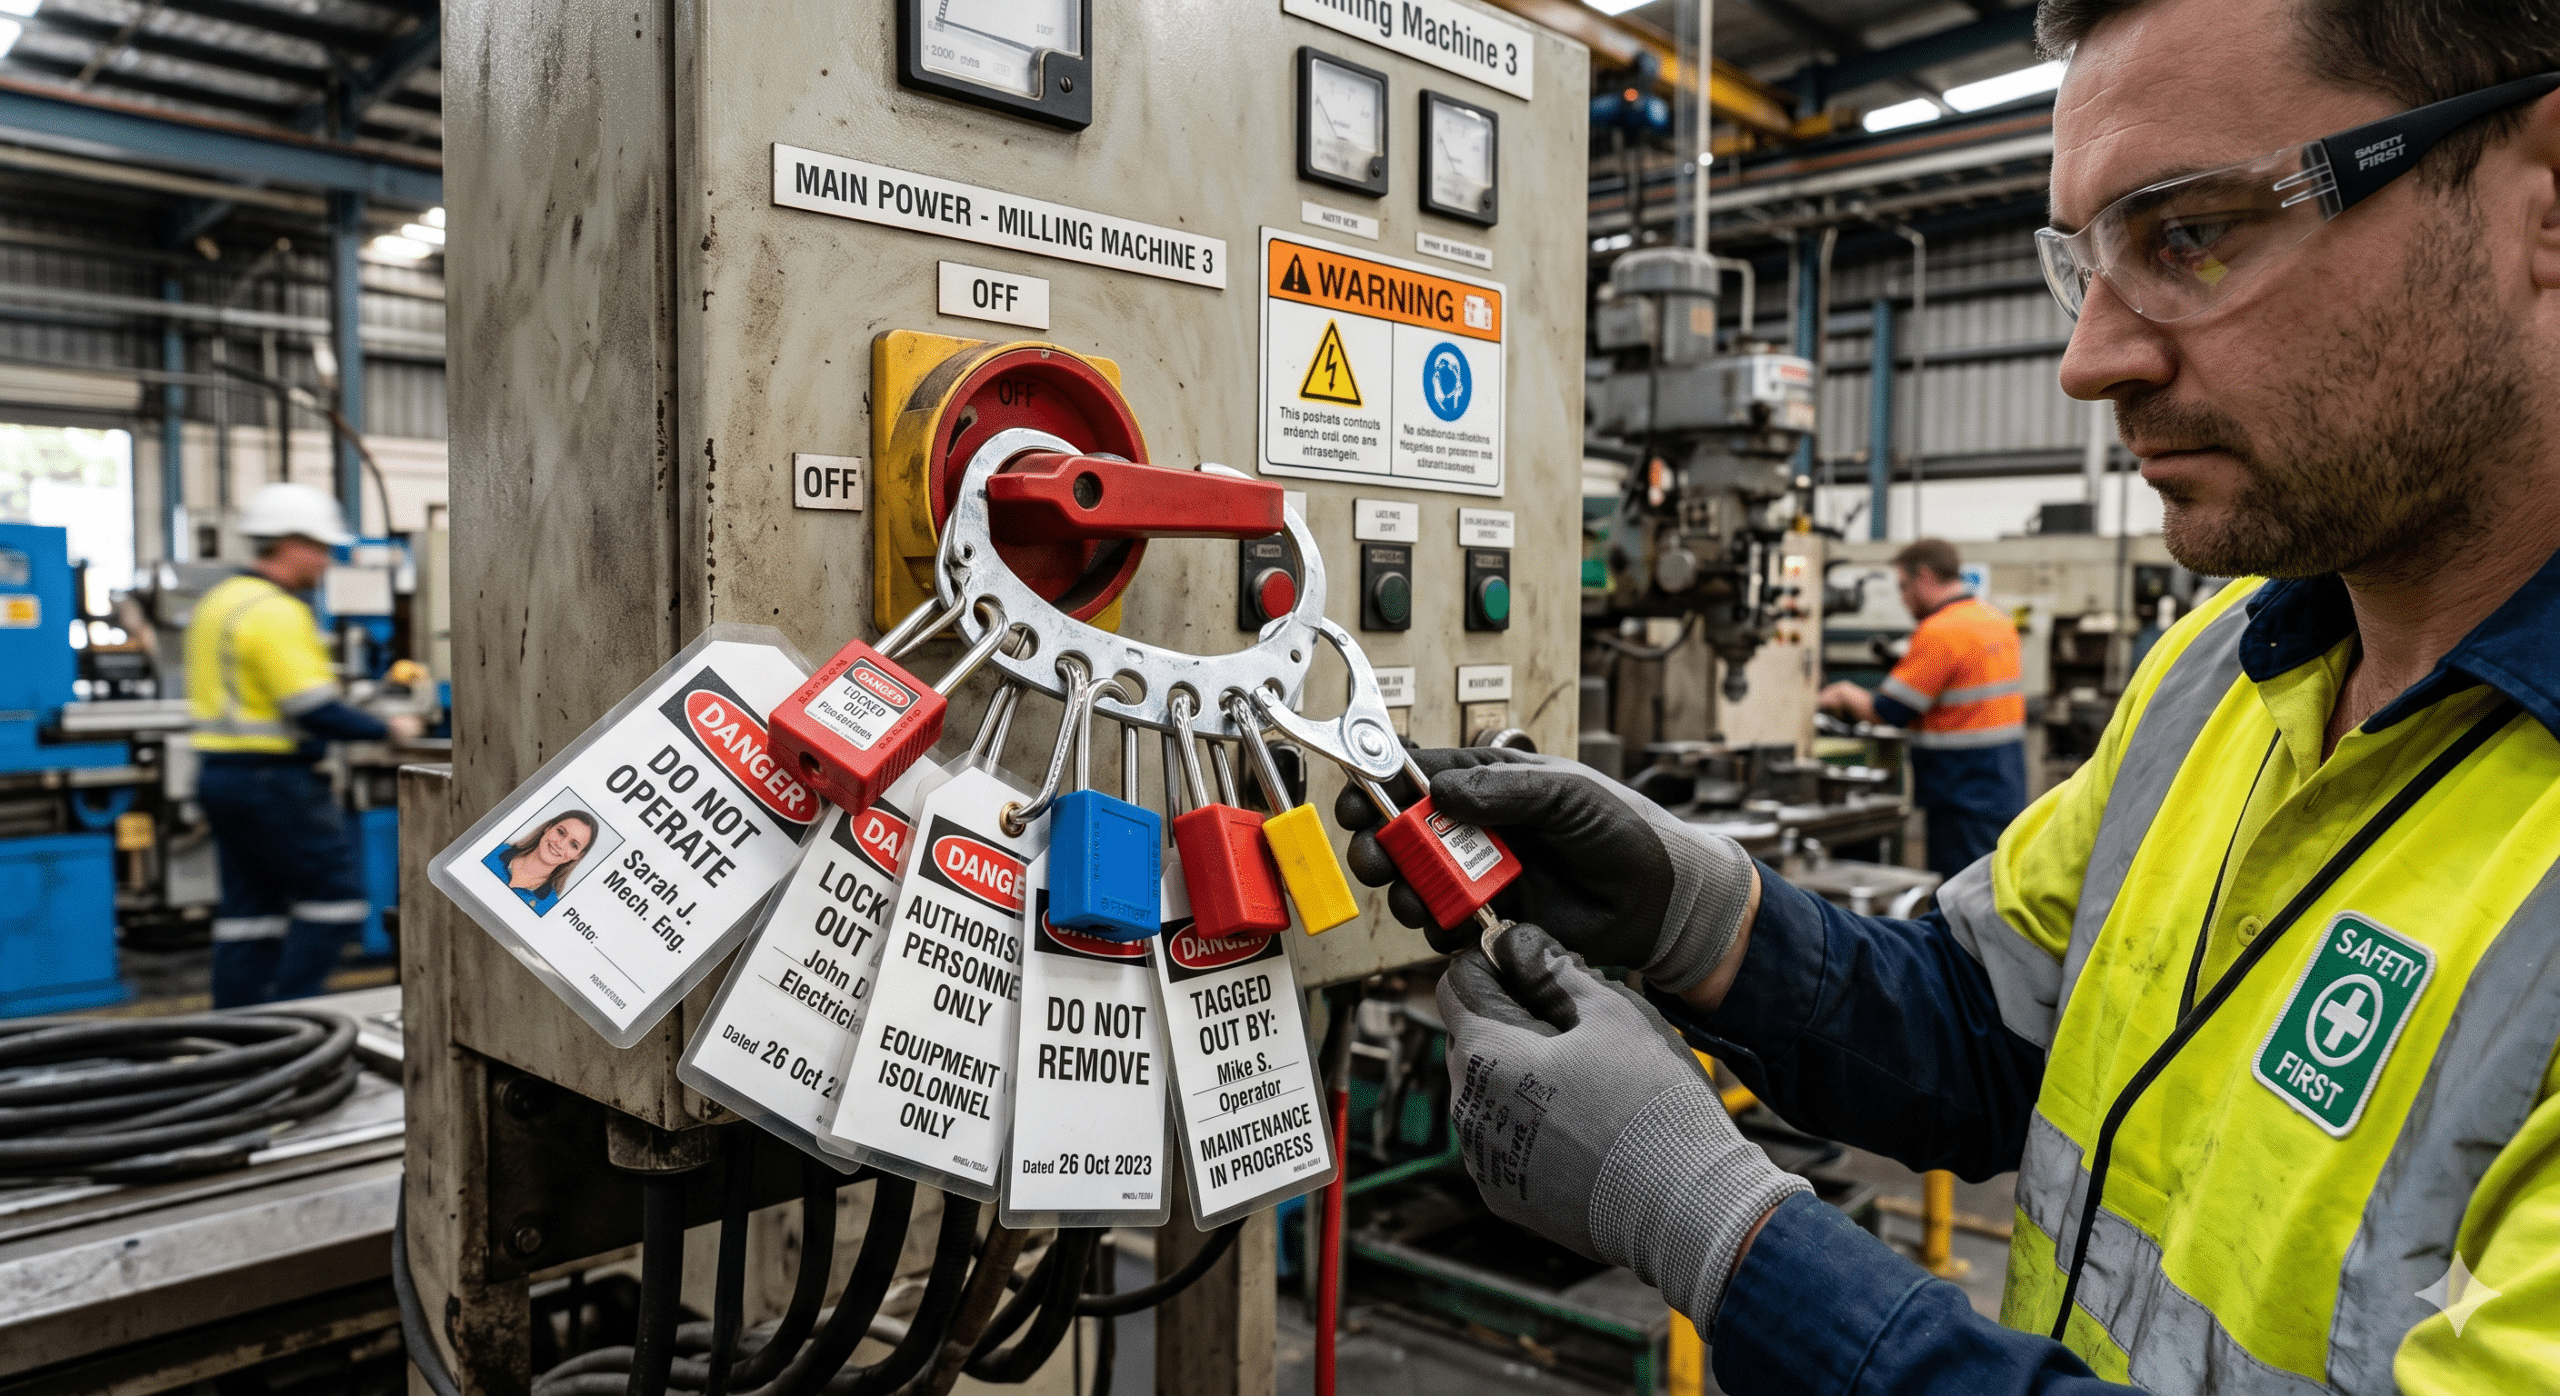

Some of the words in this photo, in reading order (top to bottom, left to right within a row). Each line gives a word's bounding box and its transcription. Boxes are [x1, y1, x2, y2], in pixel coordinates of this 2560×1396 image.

[1403, 2, 1498, 69] Machine
[1505, 43, 1518, 76] 3
[2354, 133, 2403, 159] SAFETY
[2359, 143, 2407, 171] FIRST
[795, 162, 868, 206] MAIN
[878, 179, 972, 226] POWER
[998, 204, 1093, 251] MILLING
[1101, 226, 1196, 272] MACHINE
[1202, 249, 1214, 274] 3
[972, 278, 1019, 312] OFF
[1317, 261, 1454, 323] WARNING
[1000, 379, 1037, 408] OFF
[1280, 406, 1300, 420] This
[803, 465, 857, 499] OFF
[843, 701, 869, 720] OUT
[858, 671, 905, 704] DANGER
[646, 744, 699, 794] DO
[691, 786, 762, 850] NOT
[605, 764, 737, 889] OPERATE
[623, 849, 679, 906] Sarah
[675, 901, 698, 926] J.
[946, 844, 1026, 901] DANGE
[562, 906, 599, 944] Photo:
[602, 869, 650, 922] Mech.
[651, 914, 686, 954] Eng.
[814, 905, 873, 957] OUT
[803, 949, 850, 990] John
[902, 931, 1021, 1003] PERSONNE
[2335, 928, 2423, 988] SAFETY
[778, 967, 863, 1036] Electricia
[933, 983, 993, 1027] ONLY
[1046, 996, 1085, 1034] DO
[1094, 1001, 1147, 1040] NOT
[1189, 974, 1272, 1020] TAGGED
[1199, 1017, 1240, 1056] OUT
[1246, 1008, 1278, 1042] BY:
[760, 1040, 790, 1070] 26
[789, 1056, 824, 1091] Oct
[1038, 1043, 1151, 1086] REMOVE
[1216, 1058, 1253, 1086] Mike
[1256, 1051, 1272, 1073] S.
[2274, 1050, 2345, 1110] FIRST
[878, 1059, 990, 1121] ISOLONNEL
[1219, 1079, 1282, 1114] Operator
[899, 1102, 956, 1140] ONLY
[1200, 1103, 1312, 1162] MAINTENANCE
[1022, 1159, 1055, 1174] Dated
[1058, 1153, 1079, 1175] 26
[1084, 1153, 1110, 1175] Oct
[1114, 1154, 1152, 1176] 2023
[1209, 1163, 1228, 1190] IN
[1231, 1132, 1314, 1182] PROGRESS
